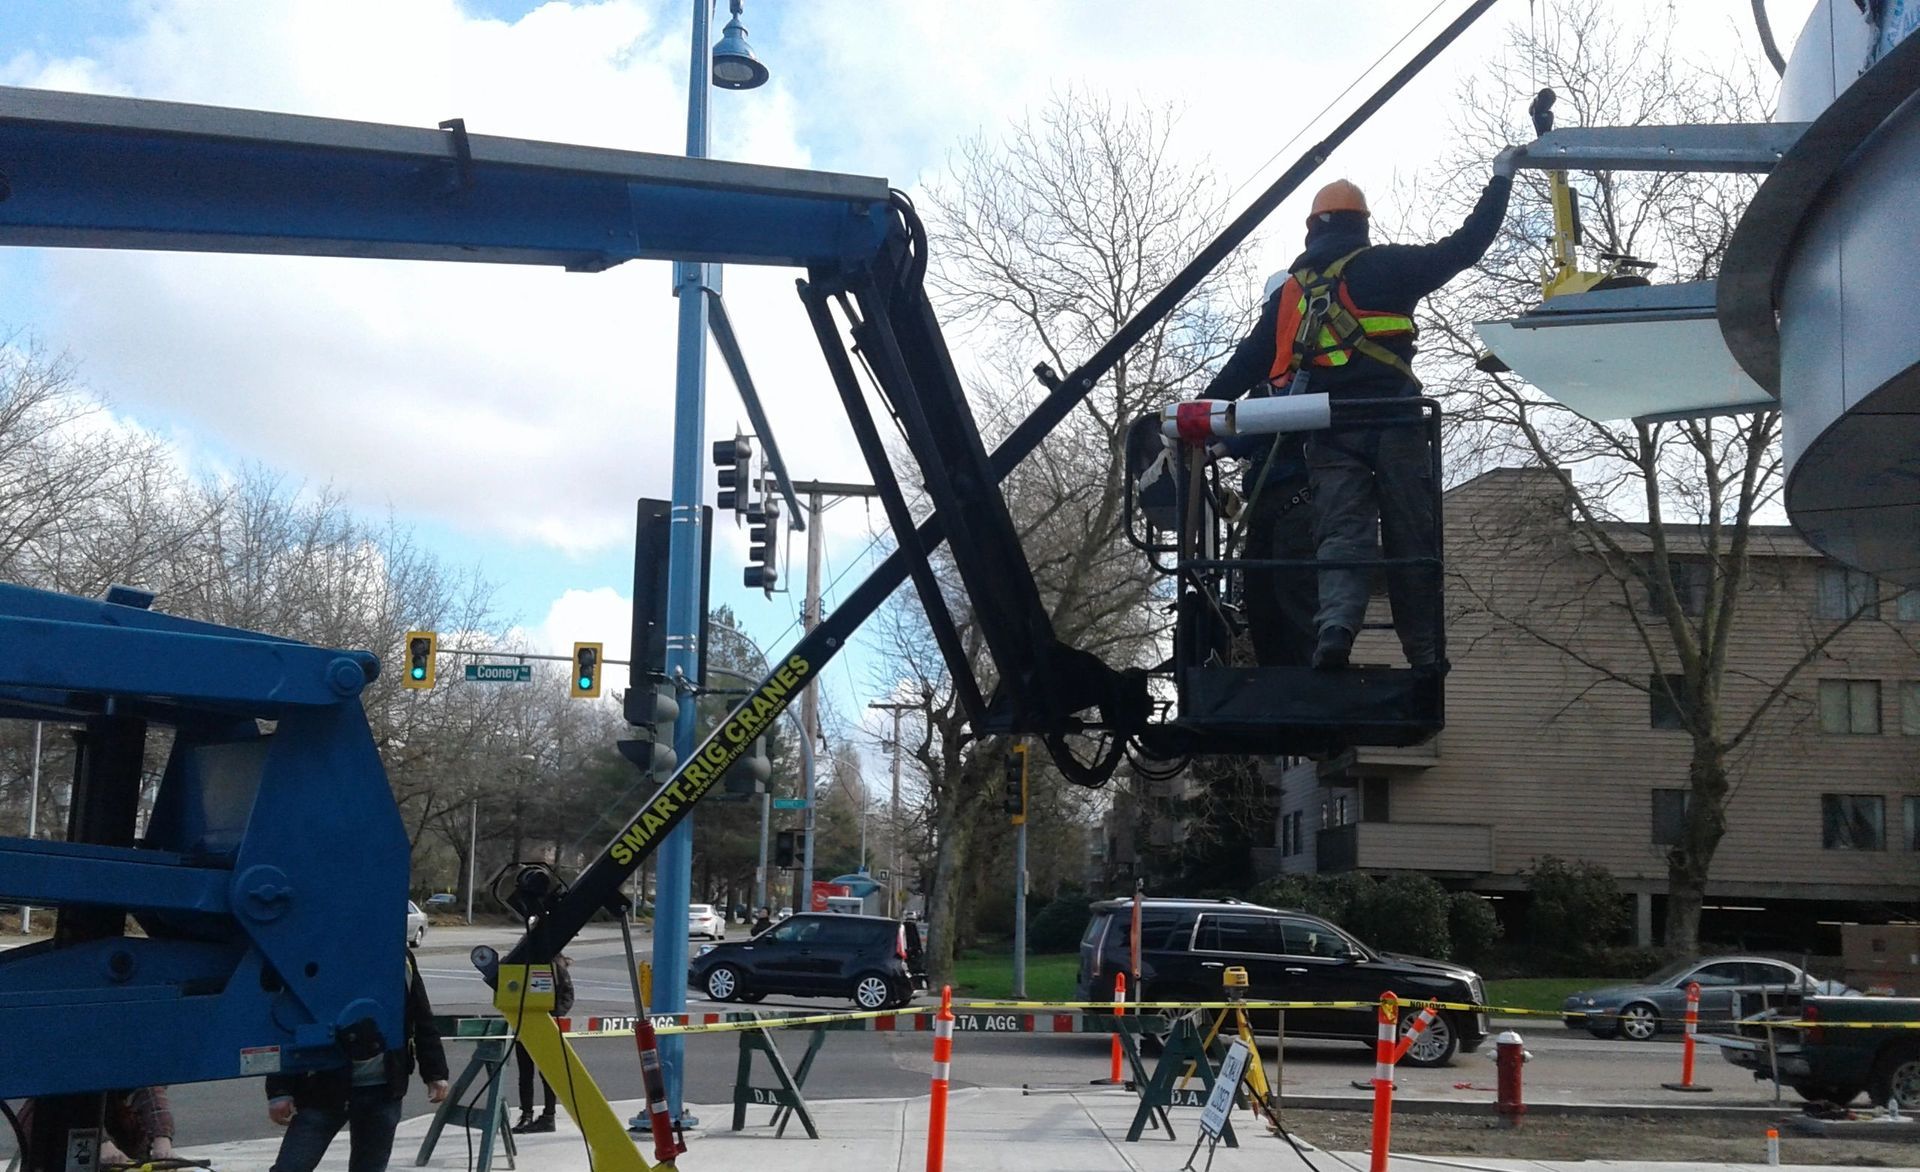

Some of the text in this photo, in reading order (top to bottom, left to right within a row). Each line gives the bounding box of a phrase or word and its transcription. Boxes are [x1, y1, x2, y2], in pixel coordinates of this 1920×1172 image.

[477, 666, 519, 680] Cooney
[725, 655, 809, 743] CRANES
[688, 699, 787, 801] www.smartrigcranes.com
[754, 1088, 781, 1104] D.A.
[1171, 1090, 1204, 1106] D.A.
